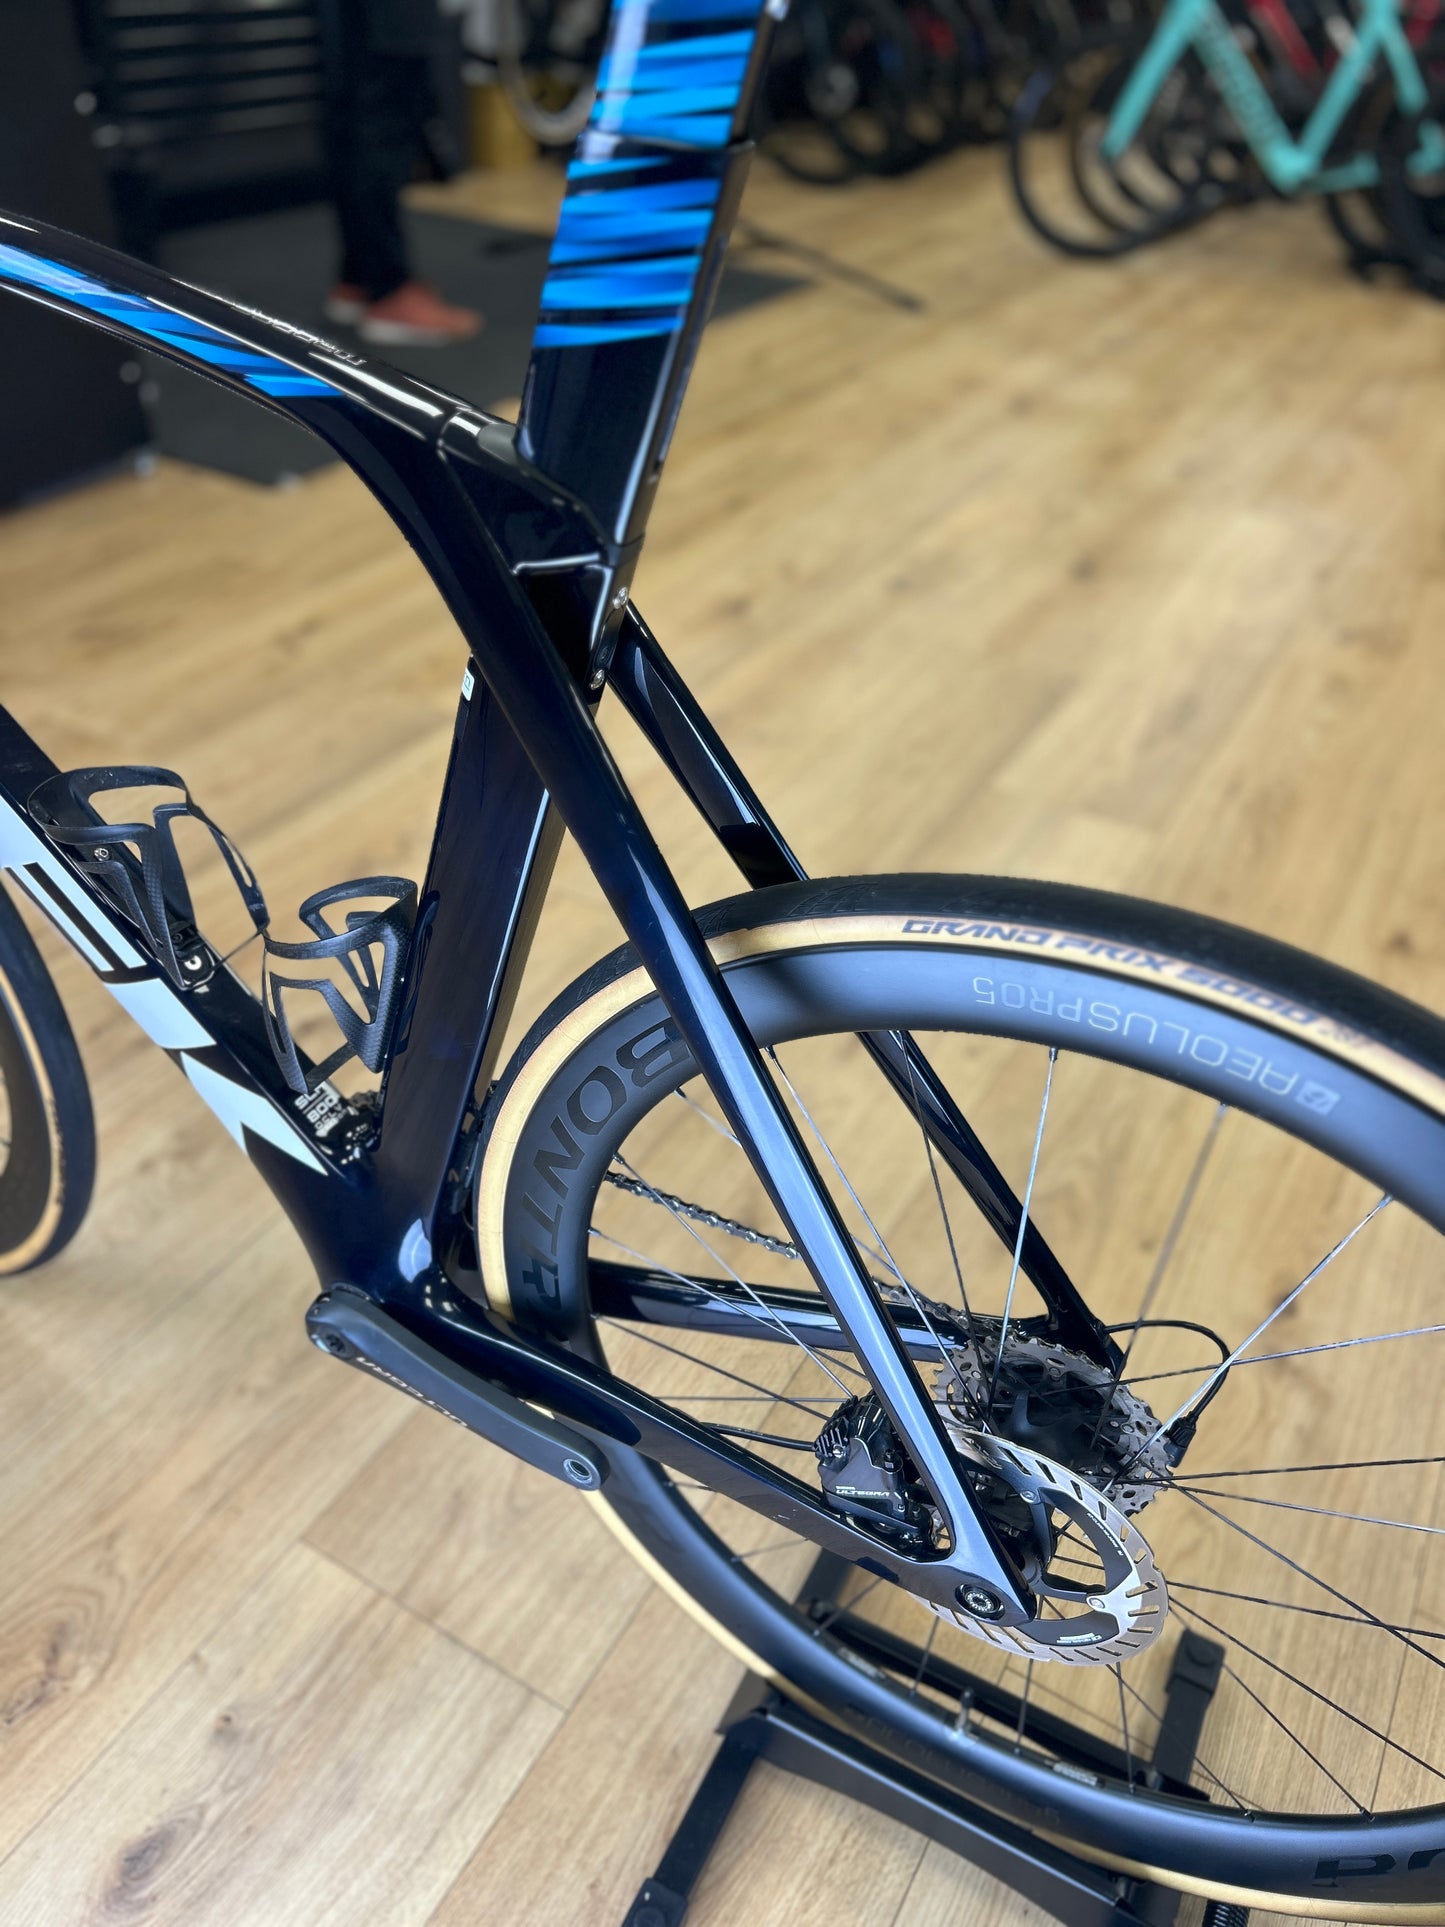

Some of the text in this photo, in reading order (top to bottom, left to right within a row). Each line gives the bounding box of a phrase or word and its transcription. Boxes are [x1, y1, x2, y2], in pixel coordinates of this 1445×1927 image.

[901, 918, 1324, 1026] GRAND PRIX 5000
[306, 1094, 337, 1123] 800
[355, 1357, 468, 1428] ULTEGRA
